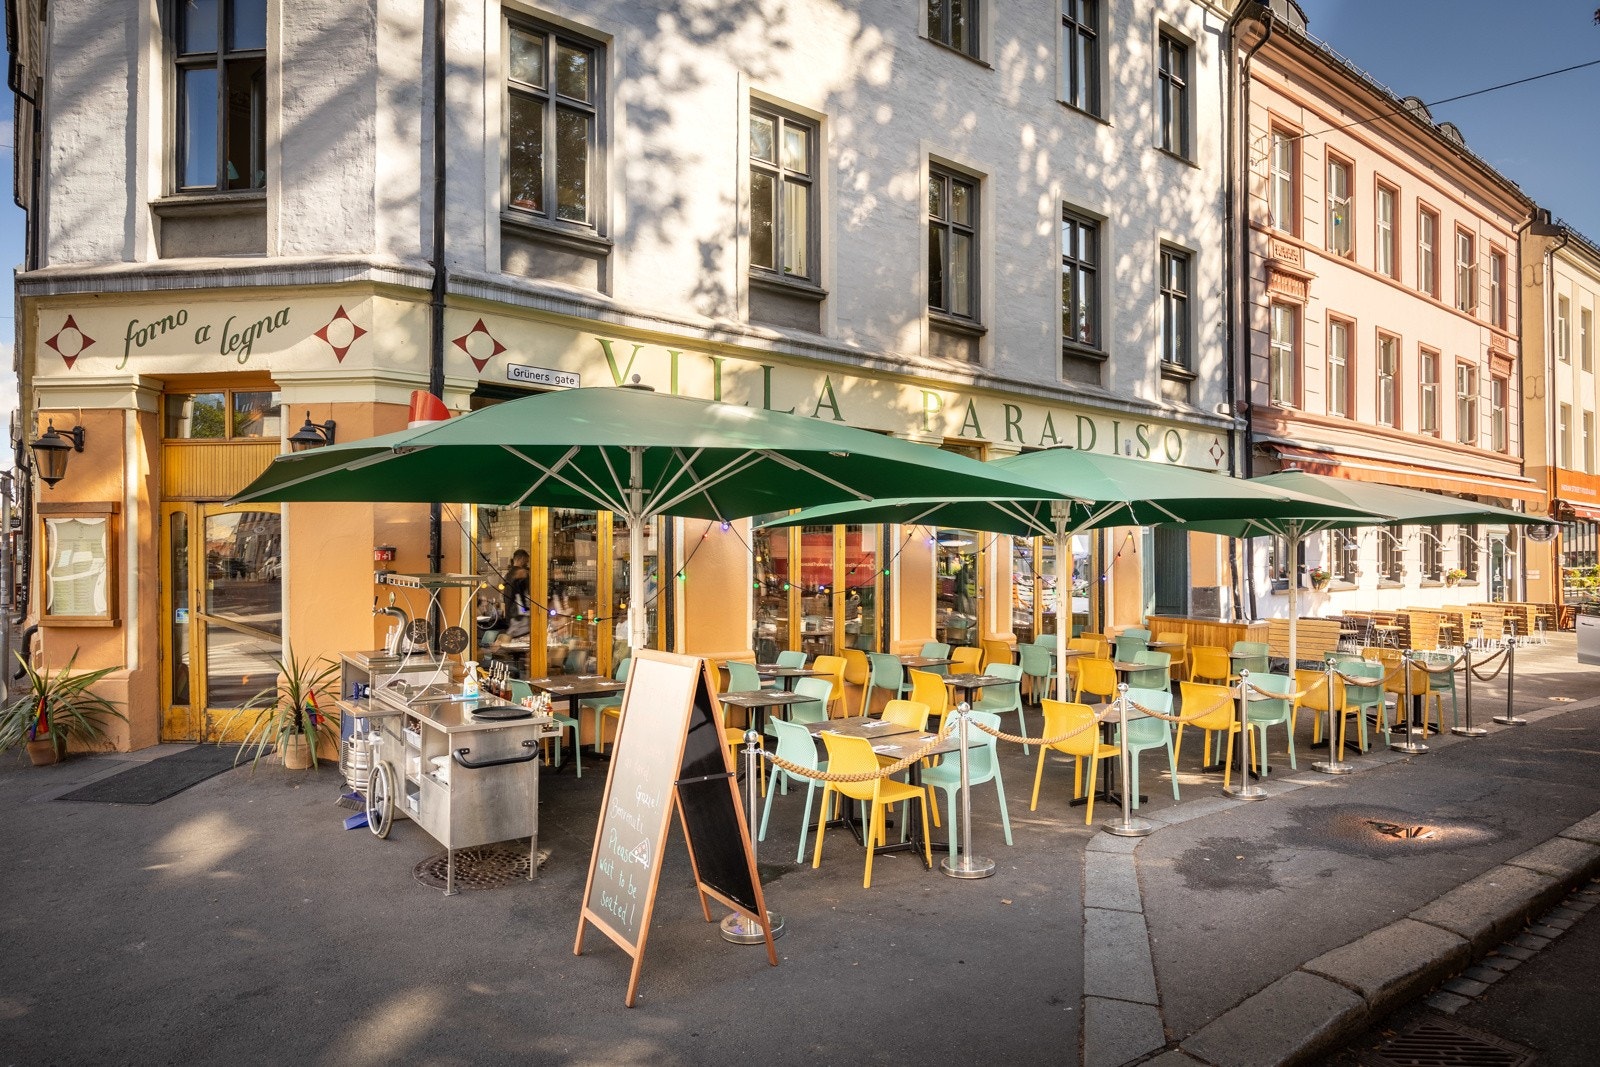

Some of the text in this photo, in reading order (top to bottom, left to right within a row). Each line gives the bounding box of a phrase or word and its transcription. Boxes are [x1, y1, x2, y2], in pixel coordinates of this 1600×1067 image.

[116, 307, 291, 370] forno a legna
[513, 367, 575, 385] Grüners gate
[594, 337, 1183, 463] VILLA PARADISO
[608, 828, 634, 864] Please
[618, 870, 626, 888] to
[627, 873, 637, 899] be
